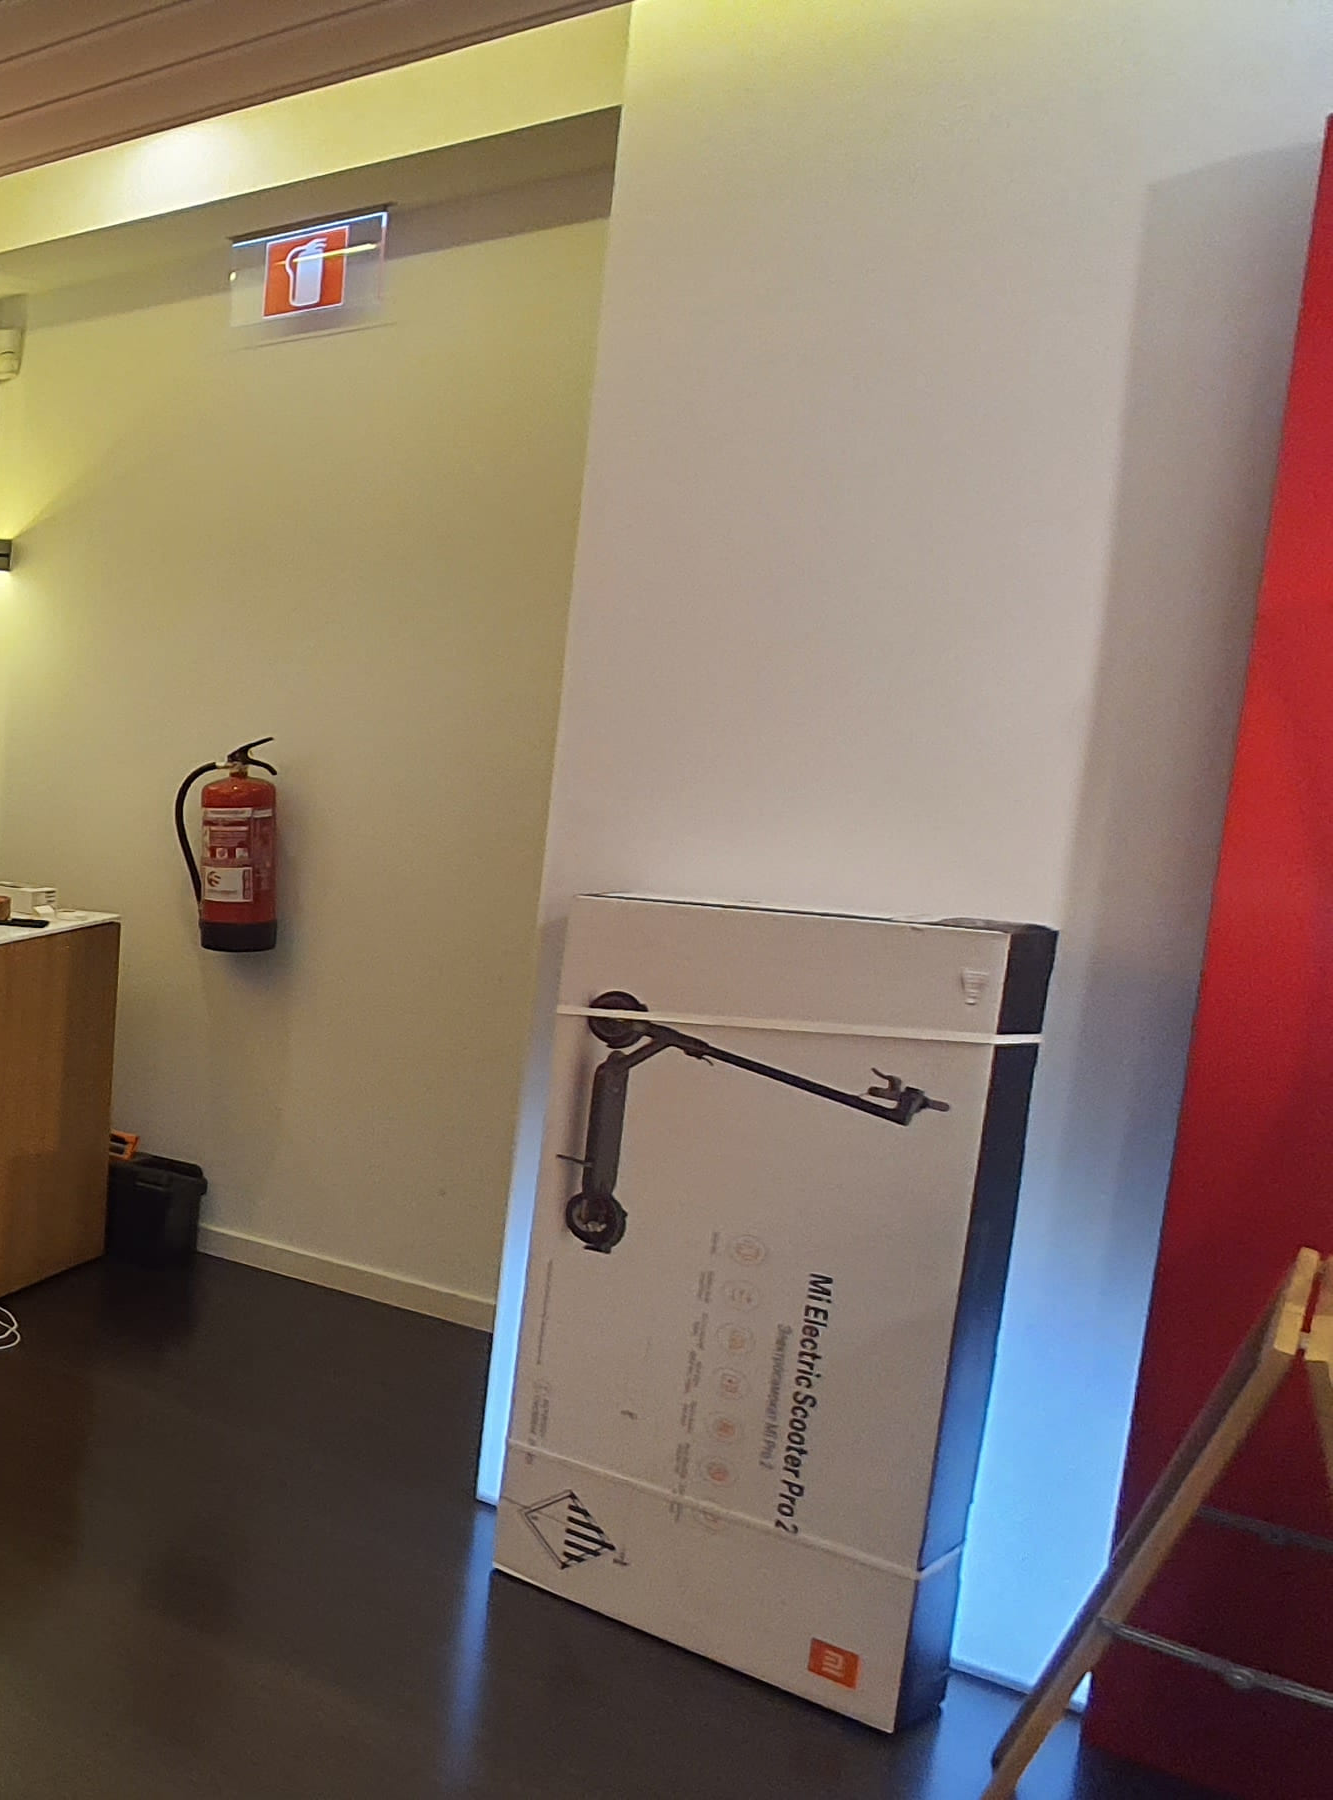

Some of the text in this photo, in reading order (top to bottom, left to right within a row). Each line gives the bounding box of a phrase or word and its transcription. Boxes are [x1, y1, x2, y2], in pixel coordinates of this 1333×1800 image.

[774, 1272, 834, 1535] Mi Electric Scooter Pro 2
